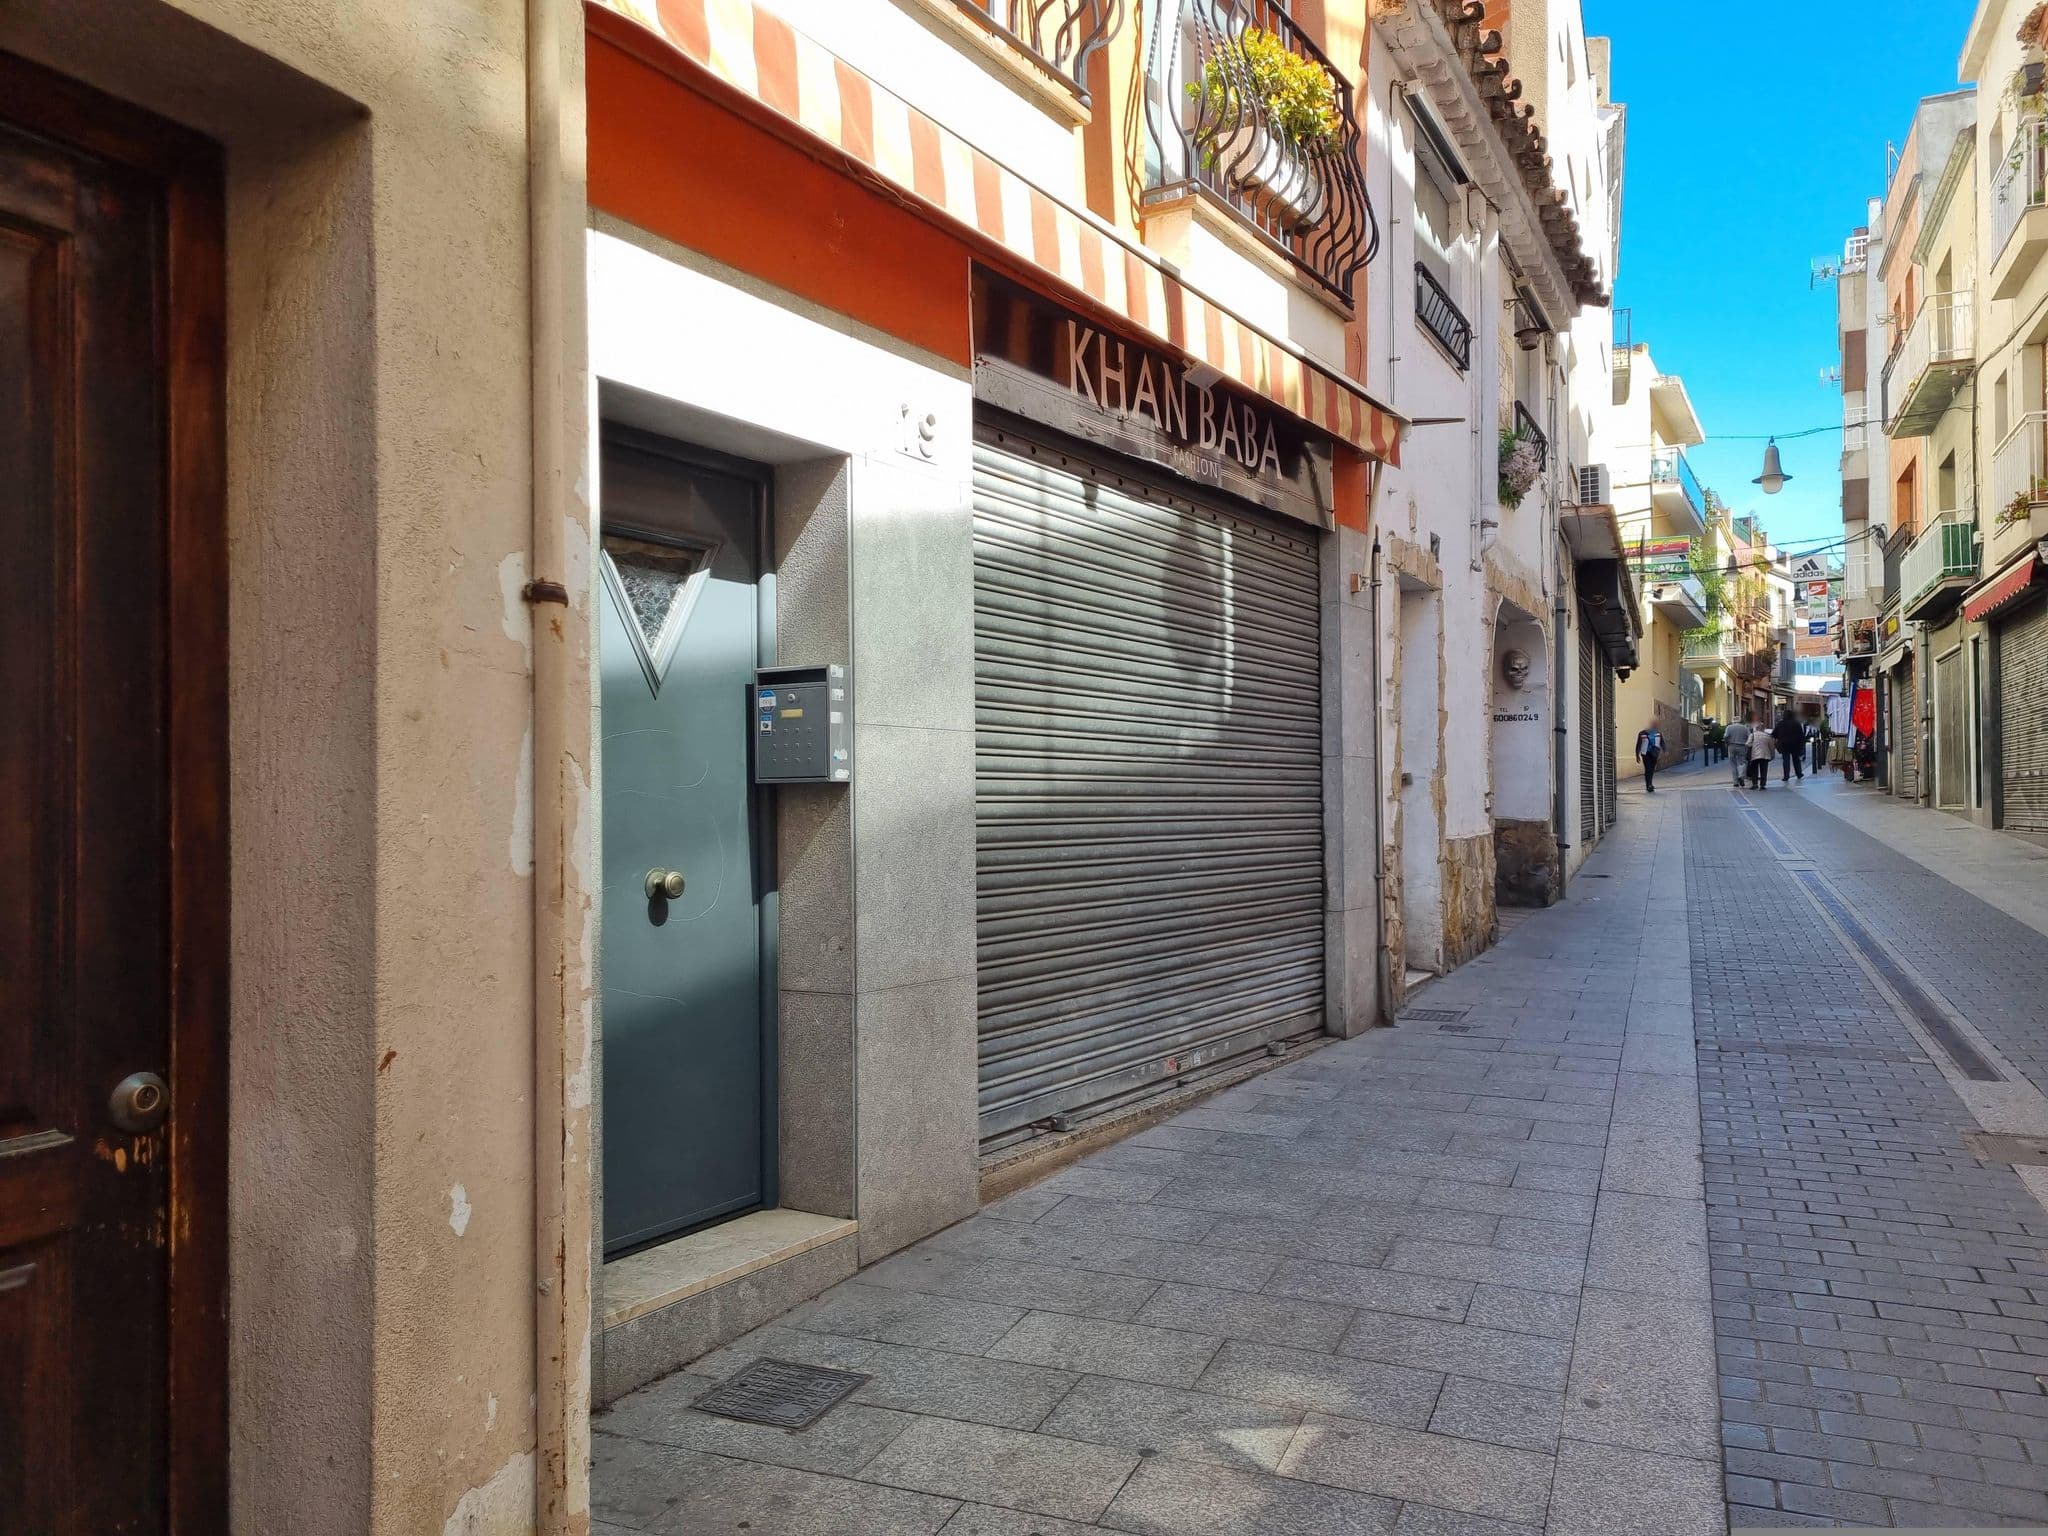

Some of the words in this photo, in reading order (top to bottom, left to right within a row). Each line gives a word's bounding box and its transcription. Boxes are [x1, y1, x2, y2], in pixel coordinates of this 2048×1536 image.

[1067, 319, 1189, 441] KHAN
[1198, 386, 1283, 481] BABA
[1171, 444, 1220, 480] FASHION
[1793, 570, 1825, 578] adidas
